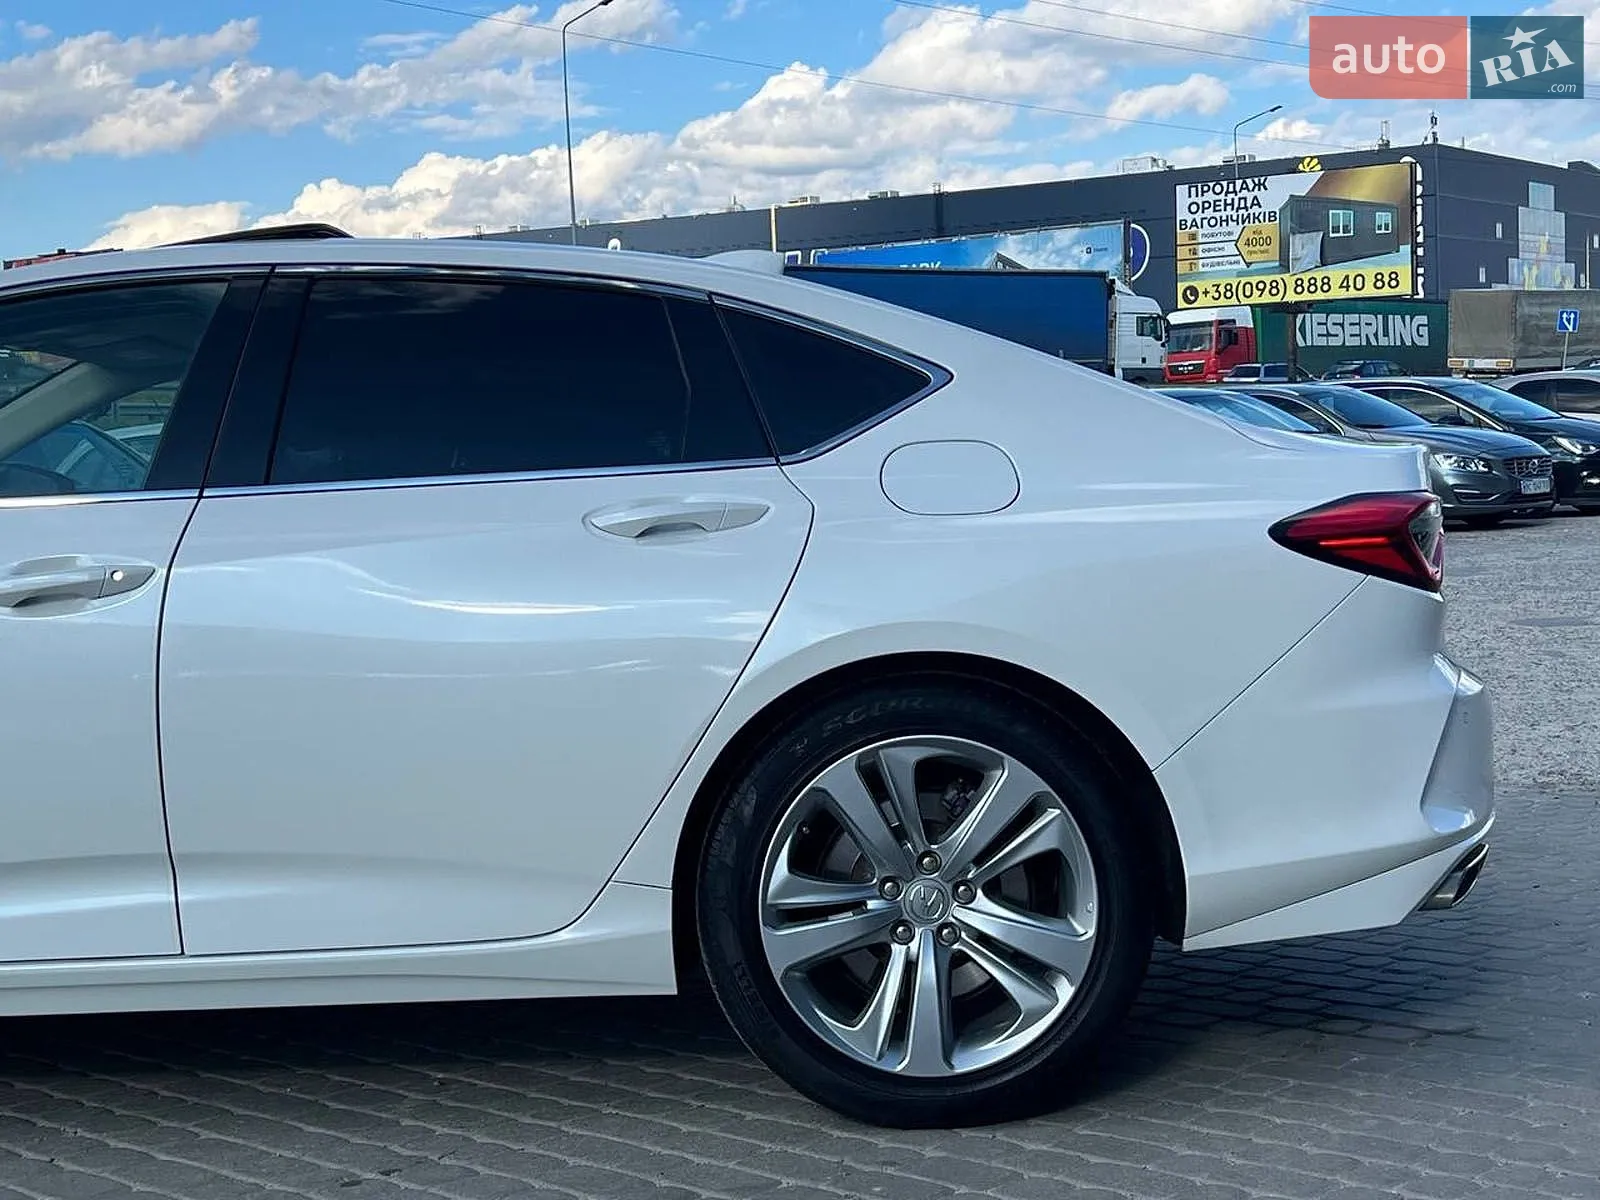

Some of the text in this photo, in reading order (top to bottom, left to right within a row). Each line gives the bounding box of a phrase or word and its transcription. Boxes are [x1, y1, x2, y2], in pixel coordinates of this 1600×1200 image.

[1187, 176, 1269, 199] ПРОДАЖ
[1187, 195, 1262, 215] ОРЕНДА
[1179, 210, 1278, 231] ВАГОНЧИКІВ
[1244, 235, 1272, 248] 4000
[1202, 271, 1401, 304] +38(098) 888 40 88
[1295, 313, 1429, 347] KIESERLING
